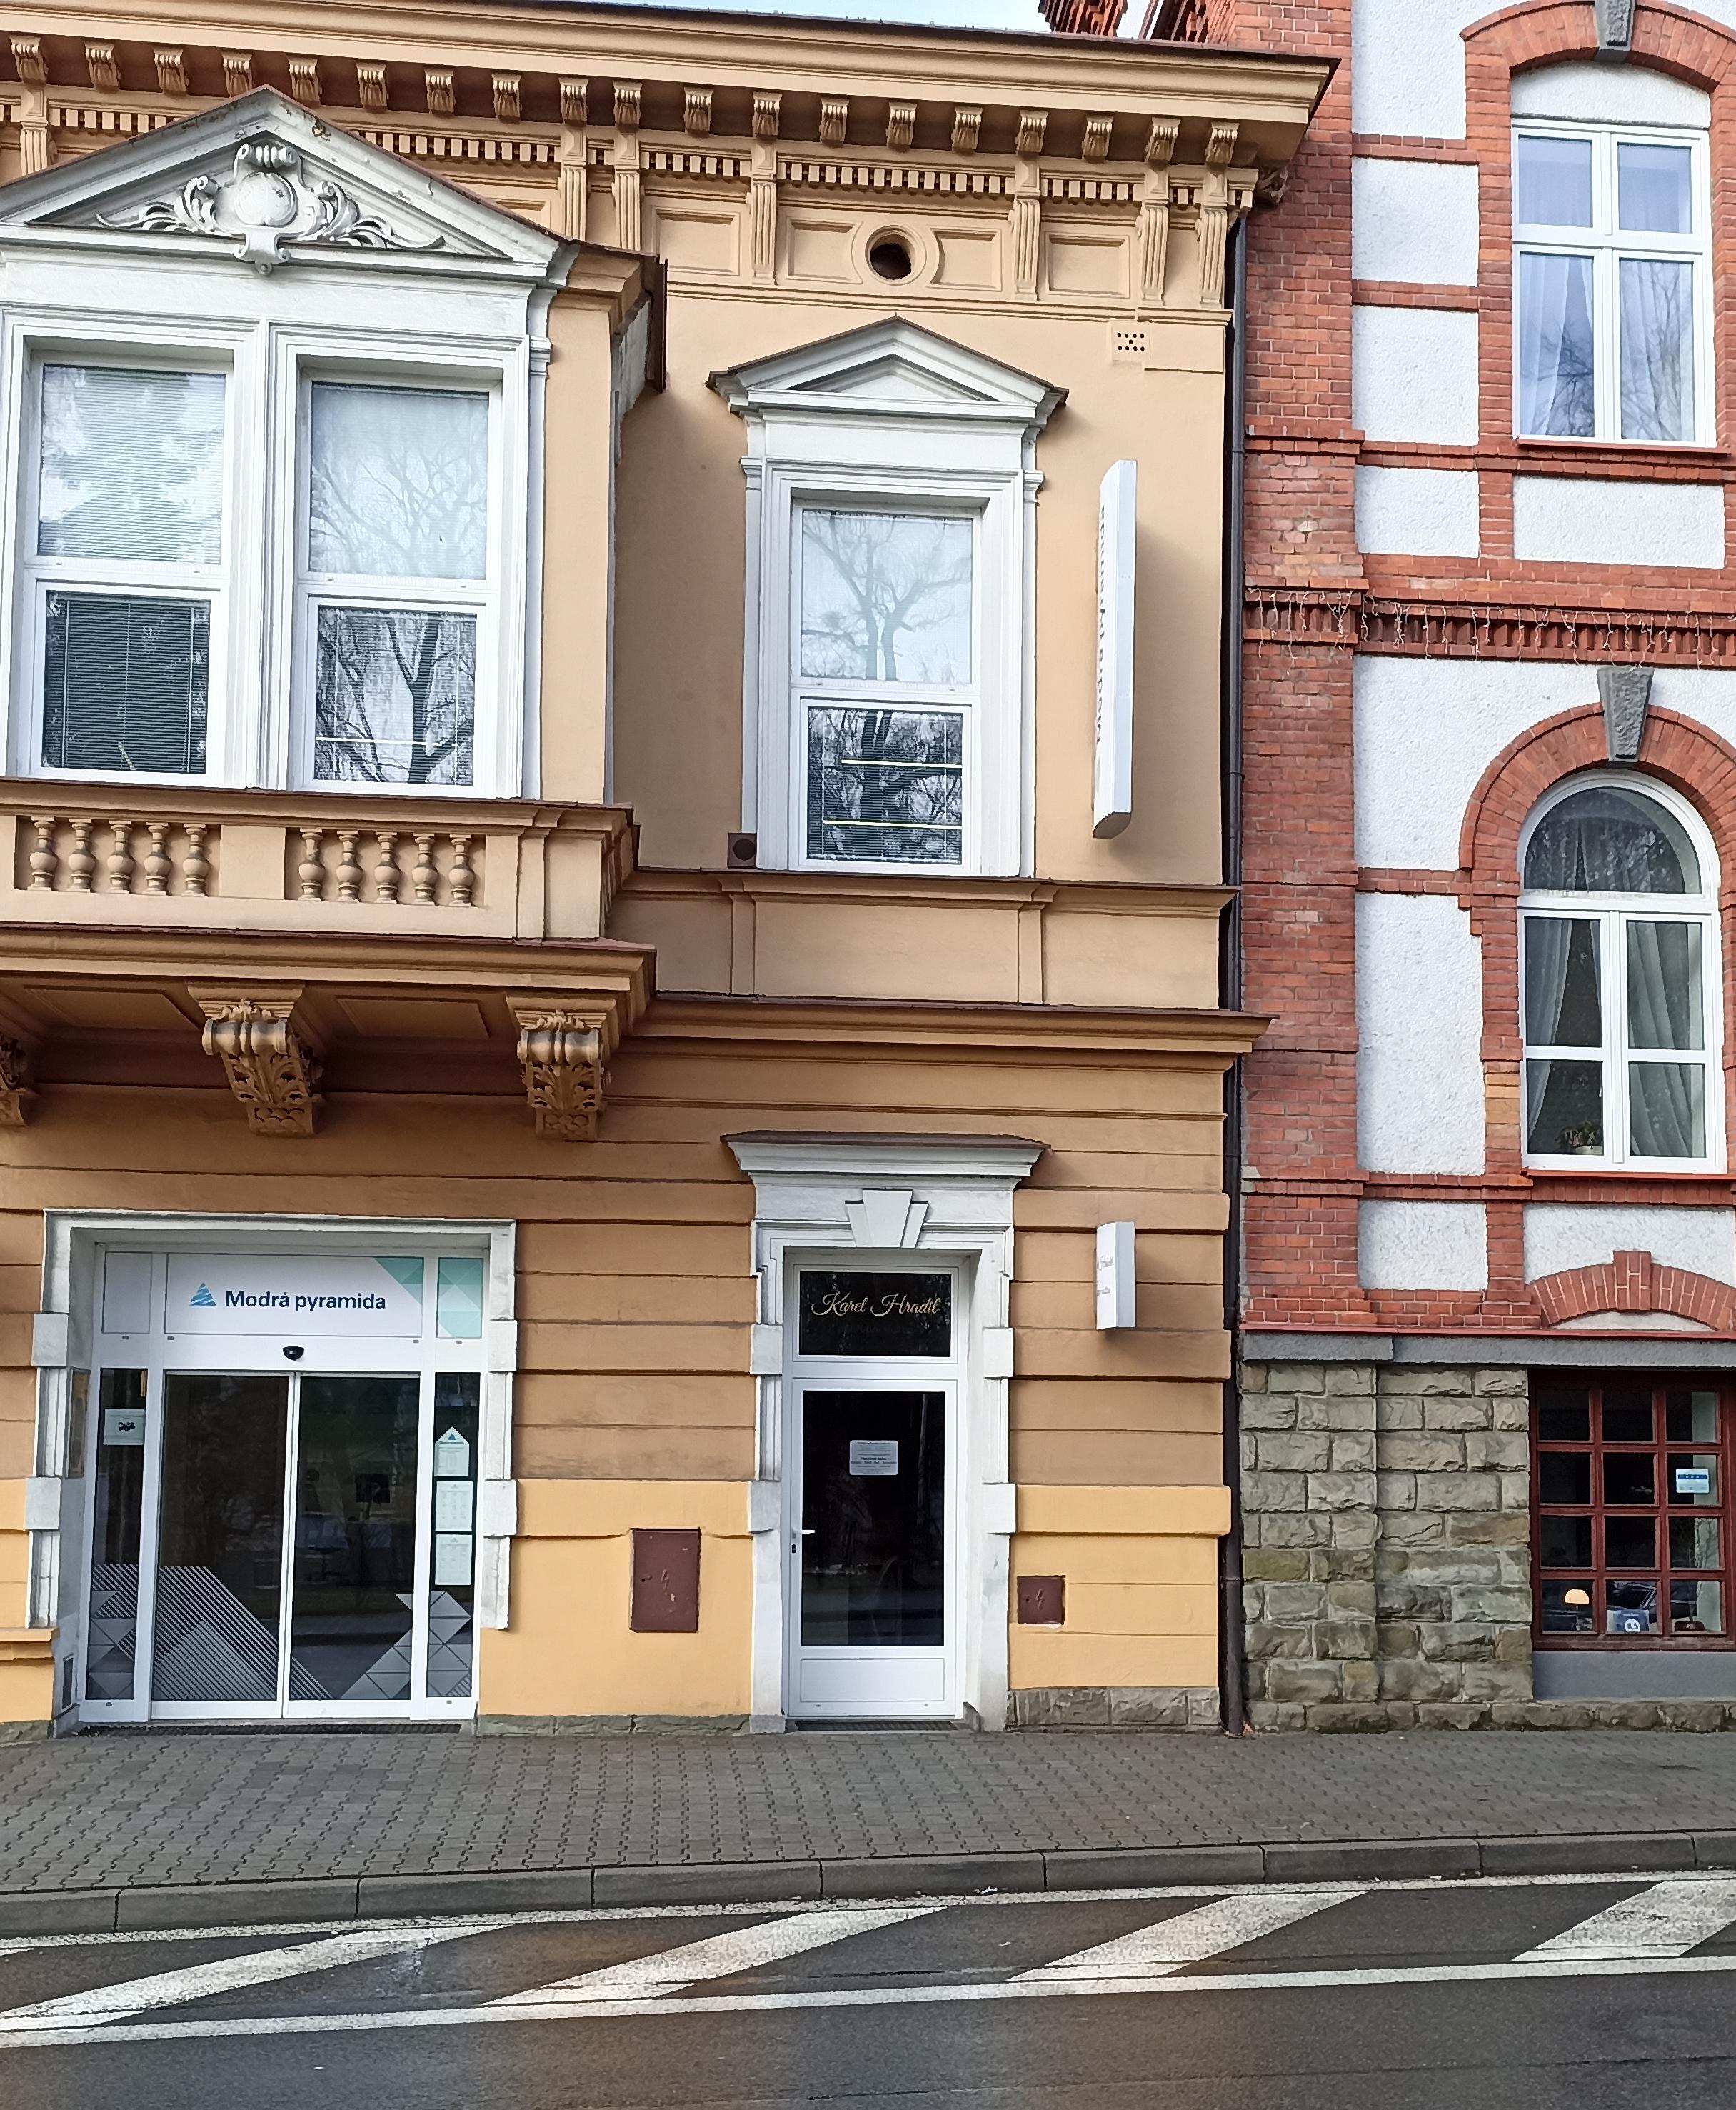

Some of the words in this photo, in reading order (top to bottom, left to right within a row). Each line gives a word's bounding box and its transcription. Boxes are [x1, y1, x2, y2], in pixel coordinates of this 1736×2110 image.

[225, 1290, 289, 1308] Modrá
[295, 1292, 386, 1311] pyramida
[811, 1291, 868, 1316] Karel
[870, 1293, 941, 1316] Hradil
